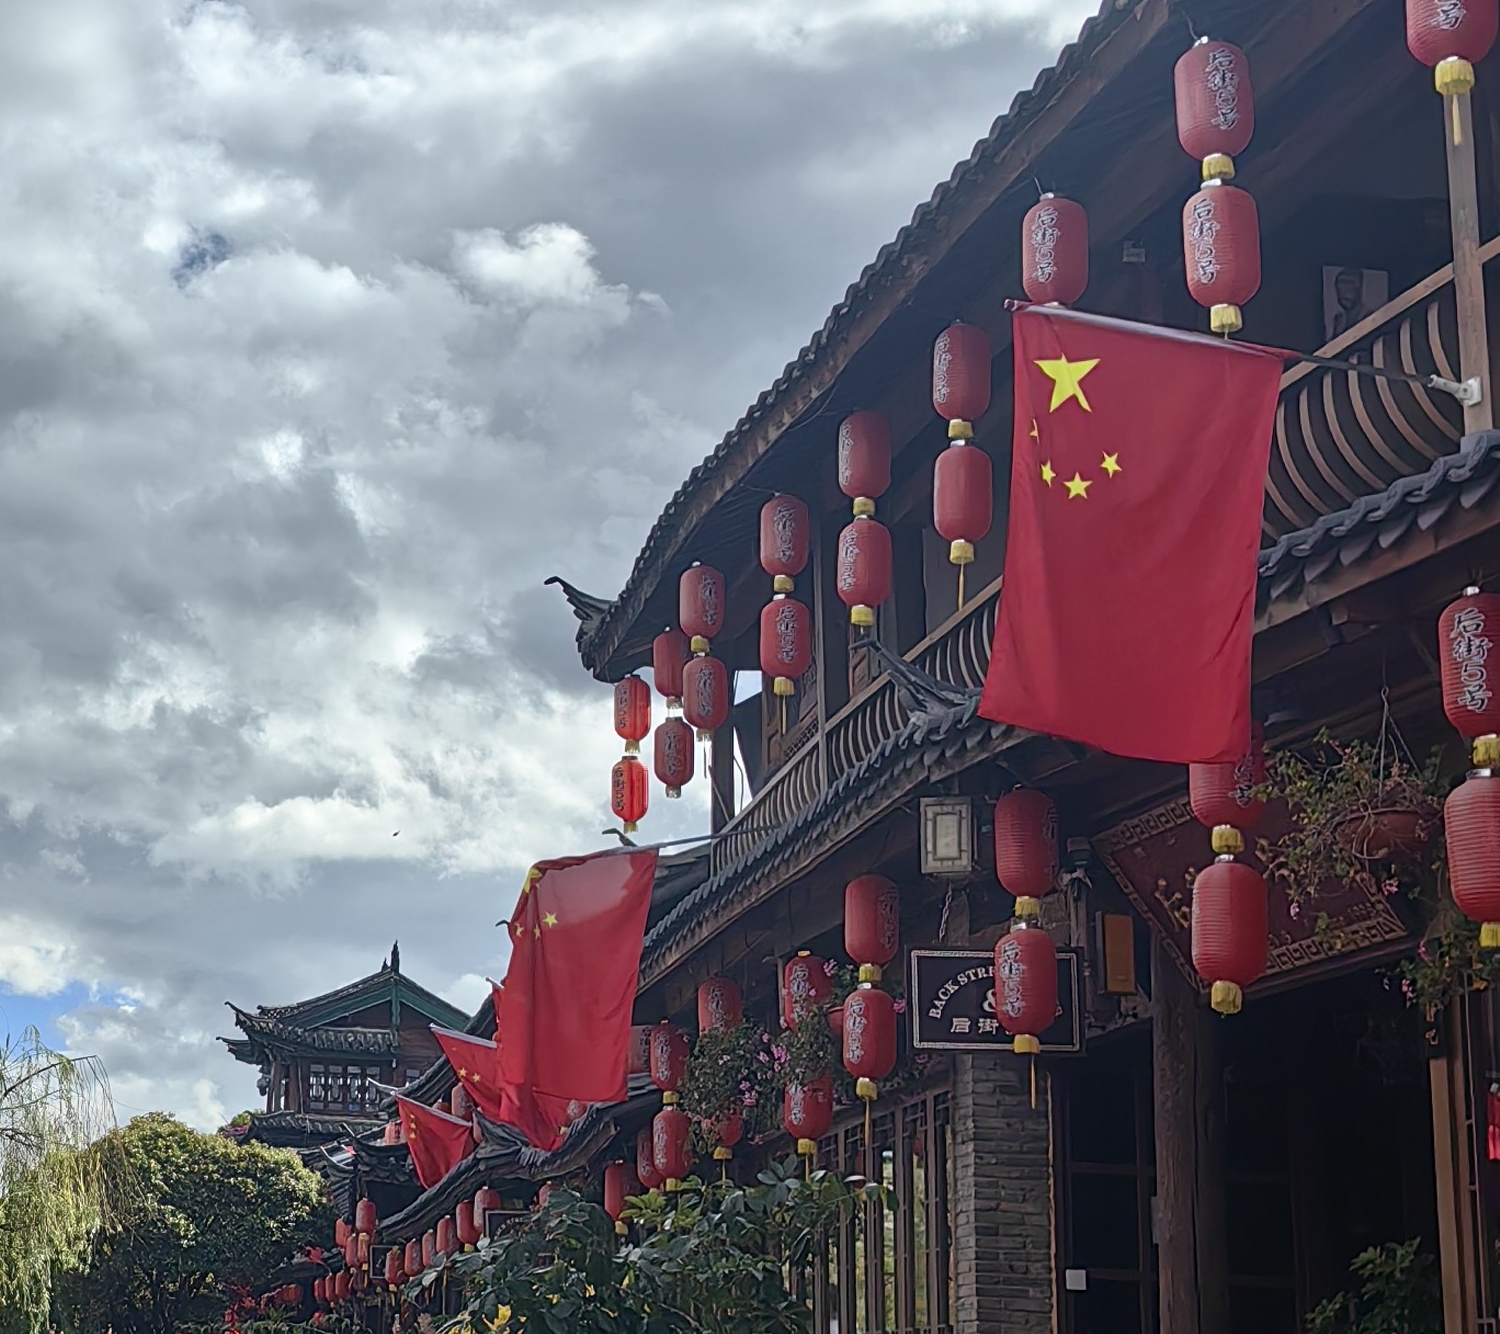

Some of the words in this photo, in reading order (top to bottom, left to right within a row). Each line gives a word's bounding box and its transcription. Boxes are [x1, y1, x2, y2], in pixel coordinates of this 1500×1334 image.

[1205, 47, 1241, 131] 后街5号
[1031, 206, 1061, 283] 后街5号
[1190, 198, 1220, 285] 后街5号
[1451, 608, 1492, 714] 后街5号
[929, 980, 959, 1019] BACK
[999, 940, 1026, 1018] 后街5号
[846, 997, 867, 1064] 后街5号
